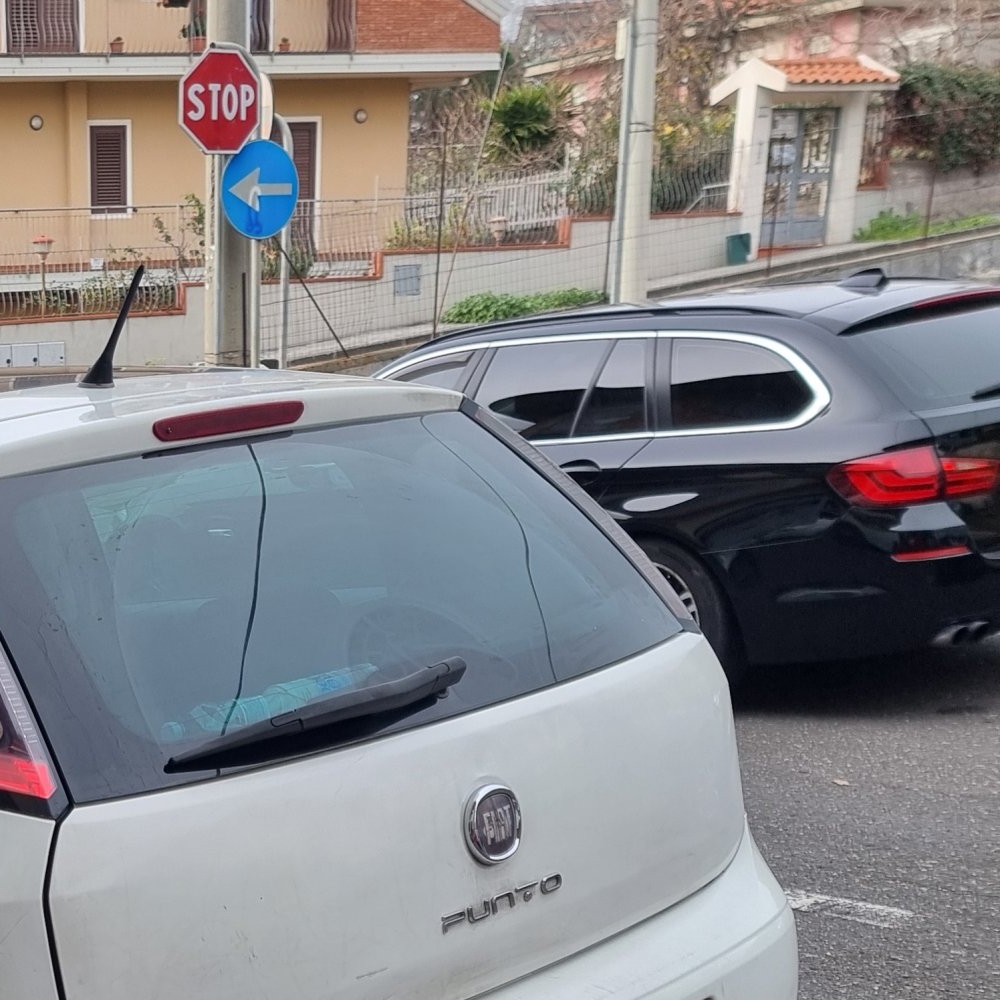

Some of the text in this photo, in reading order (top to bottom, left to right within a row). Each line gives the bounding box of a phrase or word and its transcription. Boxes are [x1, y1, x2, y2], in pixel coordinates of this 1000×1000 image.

[187, 83, 255, 121] STOP
[483, 804, 512, 846] FIAT
[441, 872, 562, 935] PUNTO
